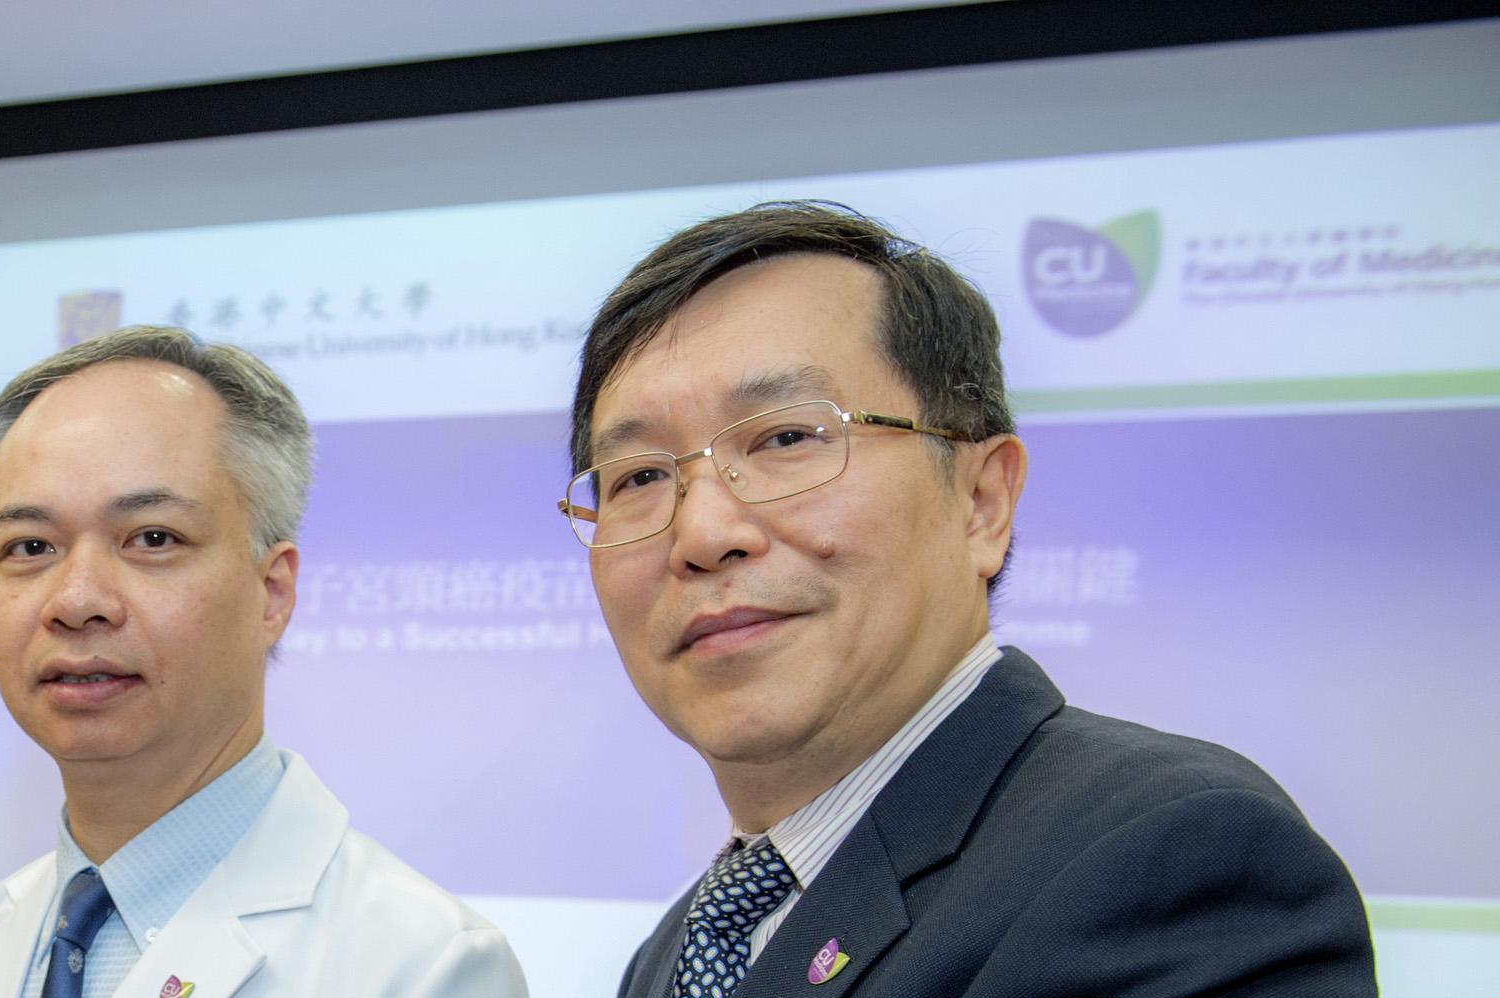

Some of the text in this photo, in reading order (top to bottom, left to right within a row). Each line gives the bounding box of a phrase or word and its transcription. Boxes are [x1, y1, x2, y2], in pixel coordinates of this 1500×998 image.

[1032, 241, 1108, 284] CU
[819, 948, 835, 966] CU
[164, 982, 180, 996] CU
